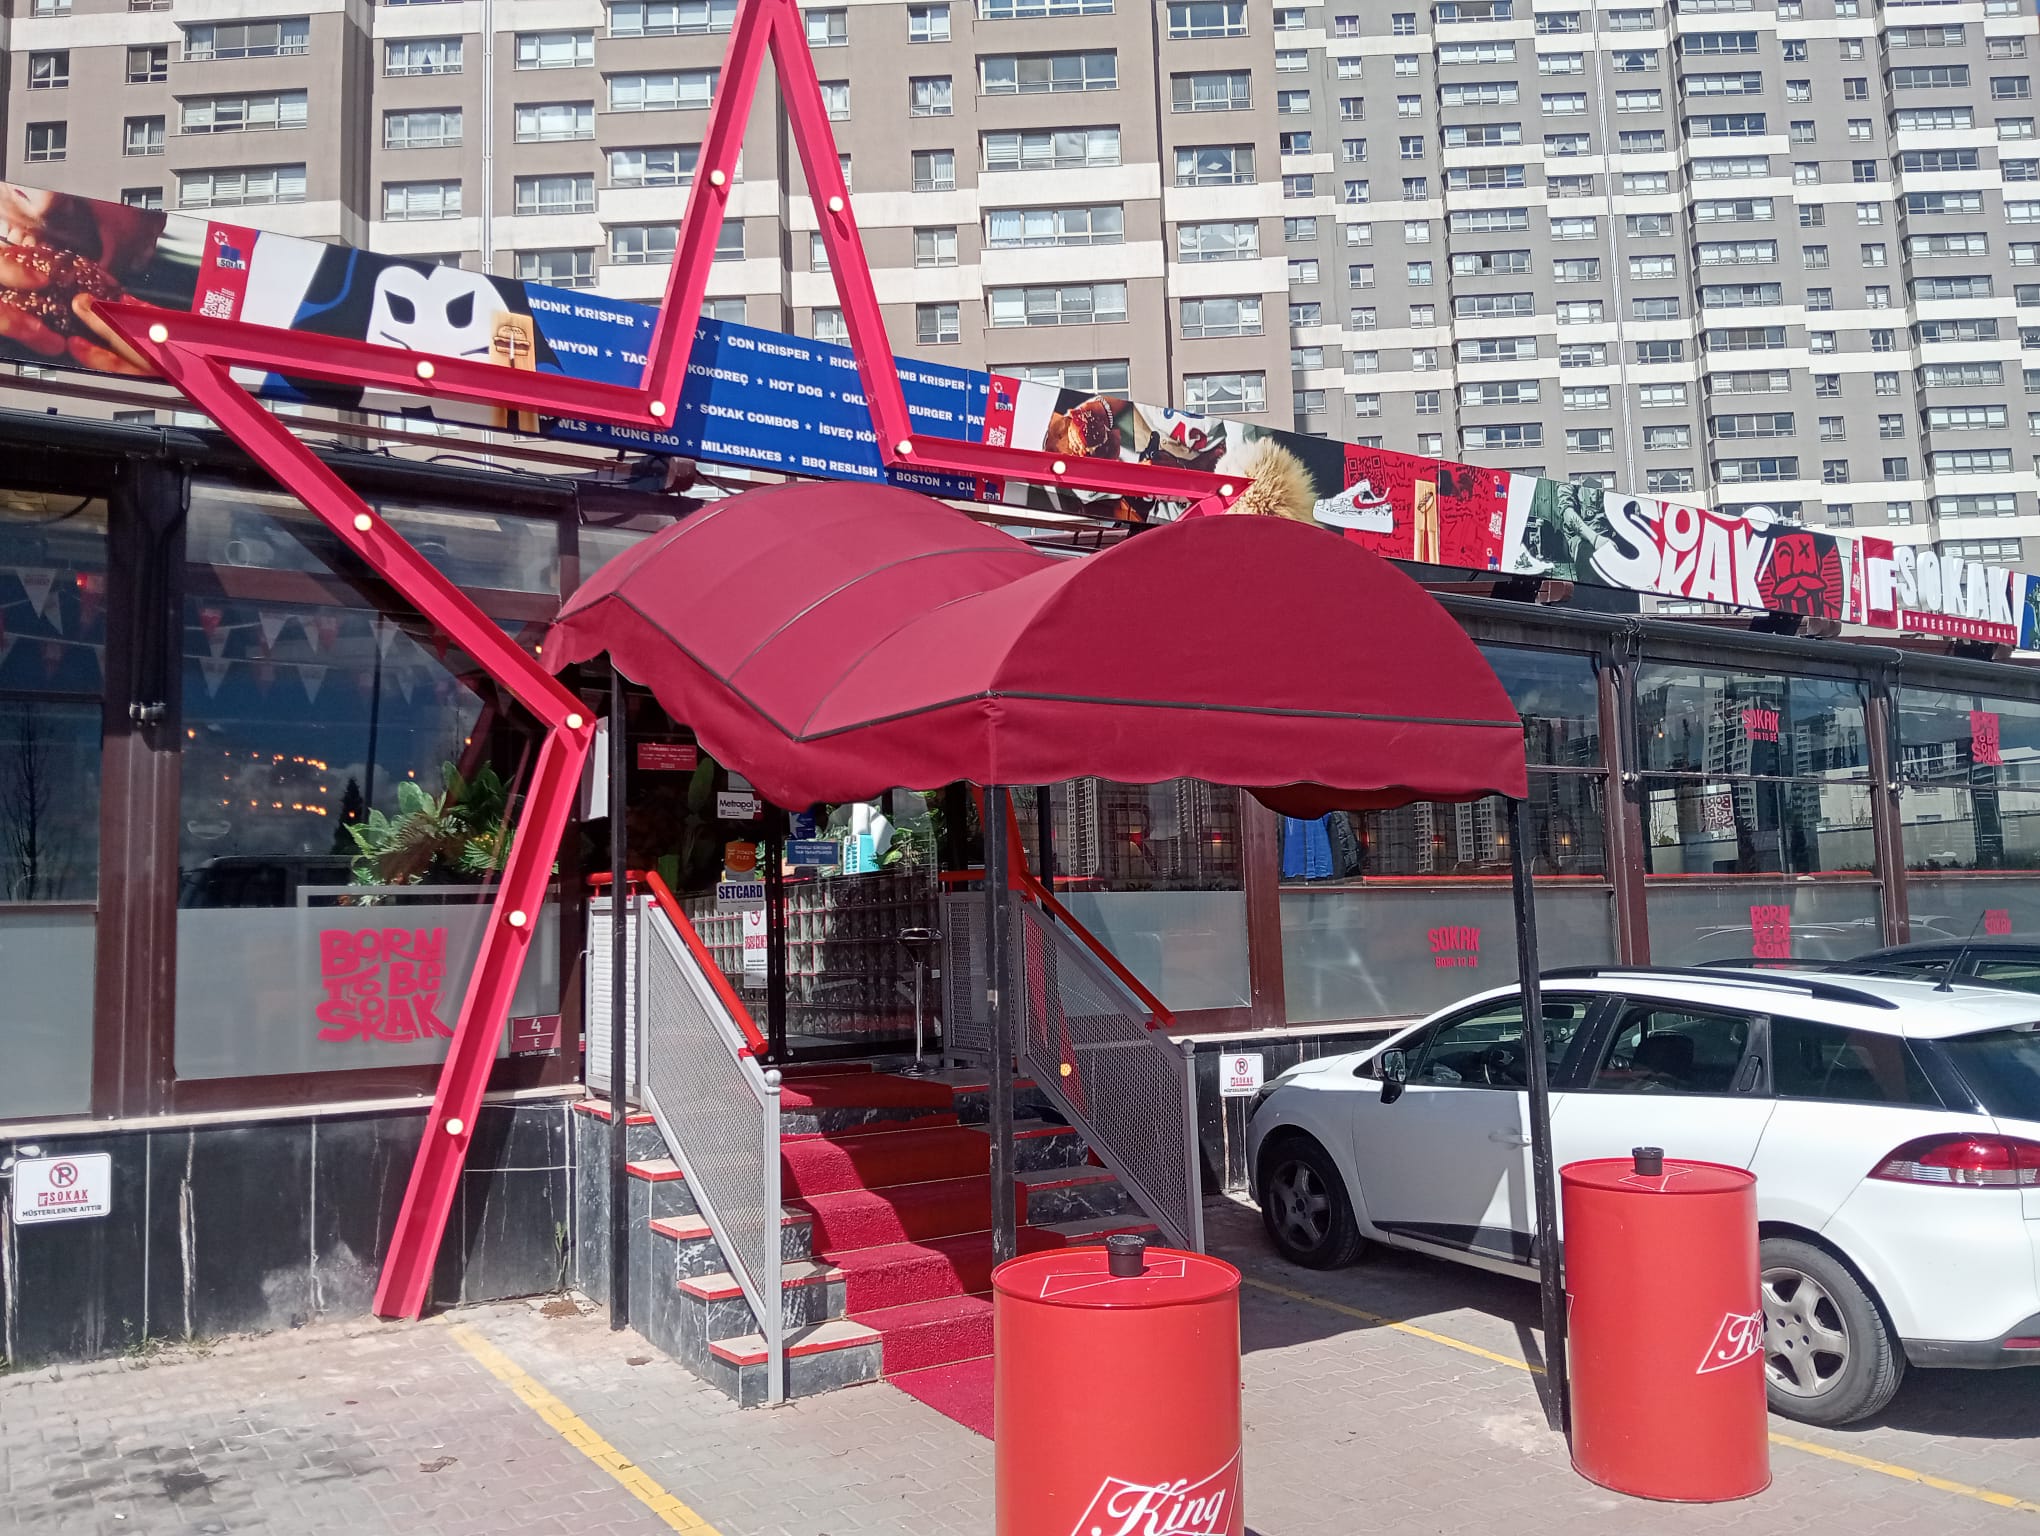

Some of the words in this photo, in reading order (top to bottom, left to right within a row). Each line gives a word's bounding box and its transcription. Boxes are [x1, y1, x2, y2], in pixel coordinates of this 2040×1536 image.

[528, 298, 571, 316] MONK
[574, 306, 634, 327] KRISPER
[546, 338, 598, 357] AMYON
[727, 336, 754, 350] CON
[758, 342, 810, 361] KRISPER
[688, 364, 749, 386] KOKOREÇ
[919, 373, 965, 390] KRISPER
[769, 378, 795, 392] HOT
[797, 385, 823, 397] DOG
[700, 403, 744, 420] SOKAK
[747, 411, 799, 429] COMBOS
[909, 404, 953, 421] BURGER
[611, 426, 650, 442] KUNG
[654, 434, 680, 446] PAO
[819, 421, 854, 441] İSVEÇ
[701, 440, 782, 462] MILKSHAKES
[802, 456, 827, 470] BBQ
[896, 471, 940, 487] BOSTON
[1988, 627, 2015, 640] HALL
[1741, 709, 1779, 732] SOKAK
[720, 800, 754, 809] Metropol
[718, 885, 763, 899] SETCARD
[1427, 926, 1481, 952] SOKAK
[319, 927, 449, 976] BORN
[531, 1018, 542, 1032] 4
[534, 1037, 541, 1047] E
[49, 1190, 88, 1201] SOKAK
[1090, 1479, 1227, 1536] King
